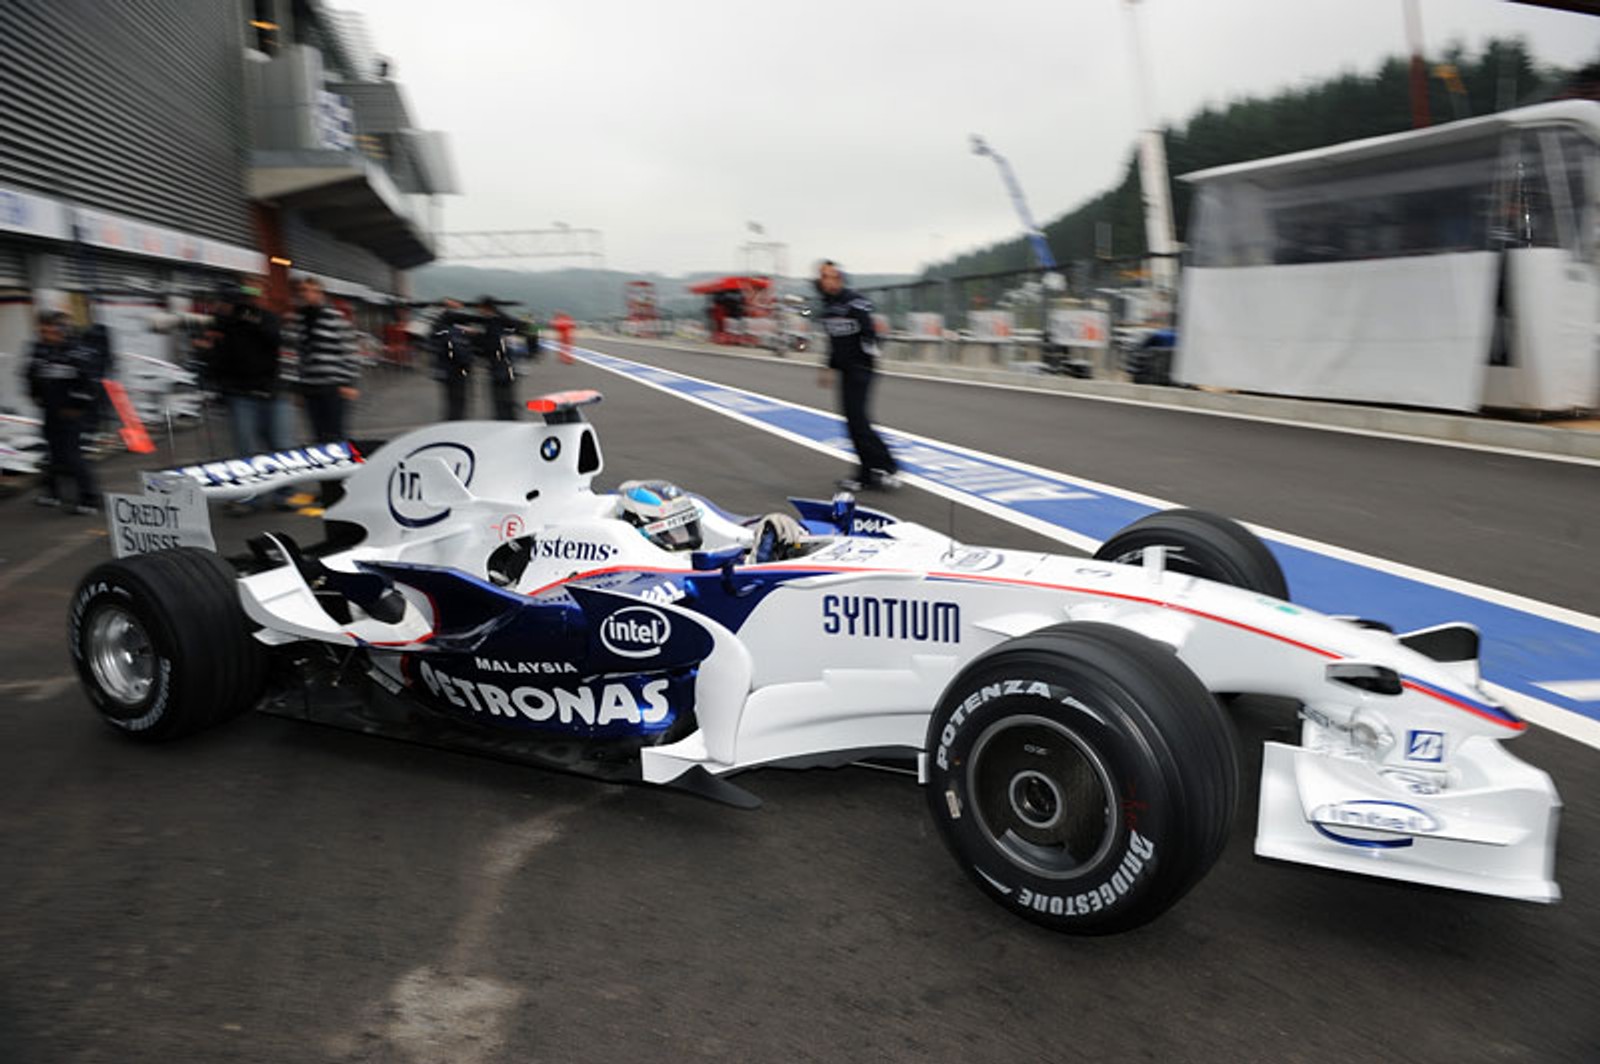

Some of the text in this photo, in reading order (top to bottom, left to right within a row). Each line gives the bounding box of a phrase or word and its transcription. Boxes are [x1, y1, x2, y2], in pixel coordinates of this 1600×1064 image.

[161, 443, 349, 485] ETRONAS
[114, 497, 181, 529] CREDIT
[530, 536, 612, 561] ystems
[608, 615, 661, 645] intel
[822, 594, 961, 644] SYNTIUM
[474, 656, 578, 674] MALAYSIA
[419, 659, 670, 726] PETRONAS
[936, 679, 1052, 771] POTENZA
[1018, 829, 1155, 916] BRIDGESTONE
